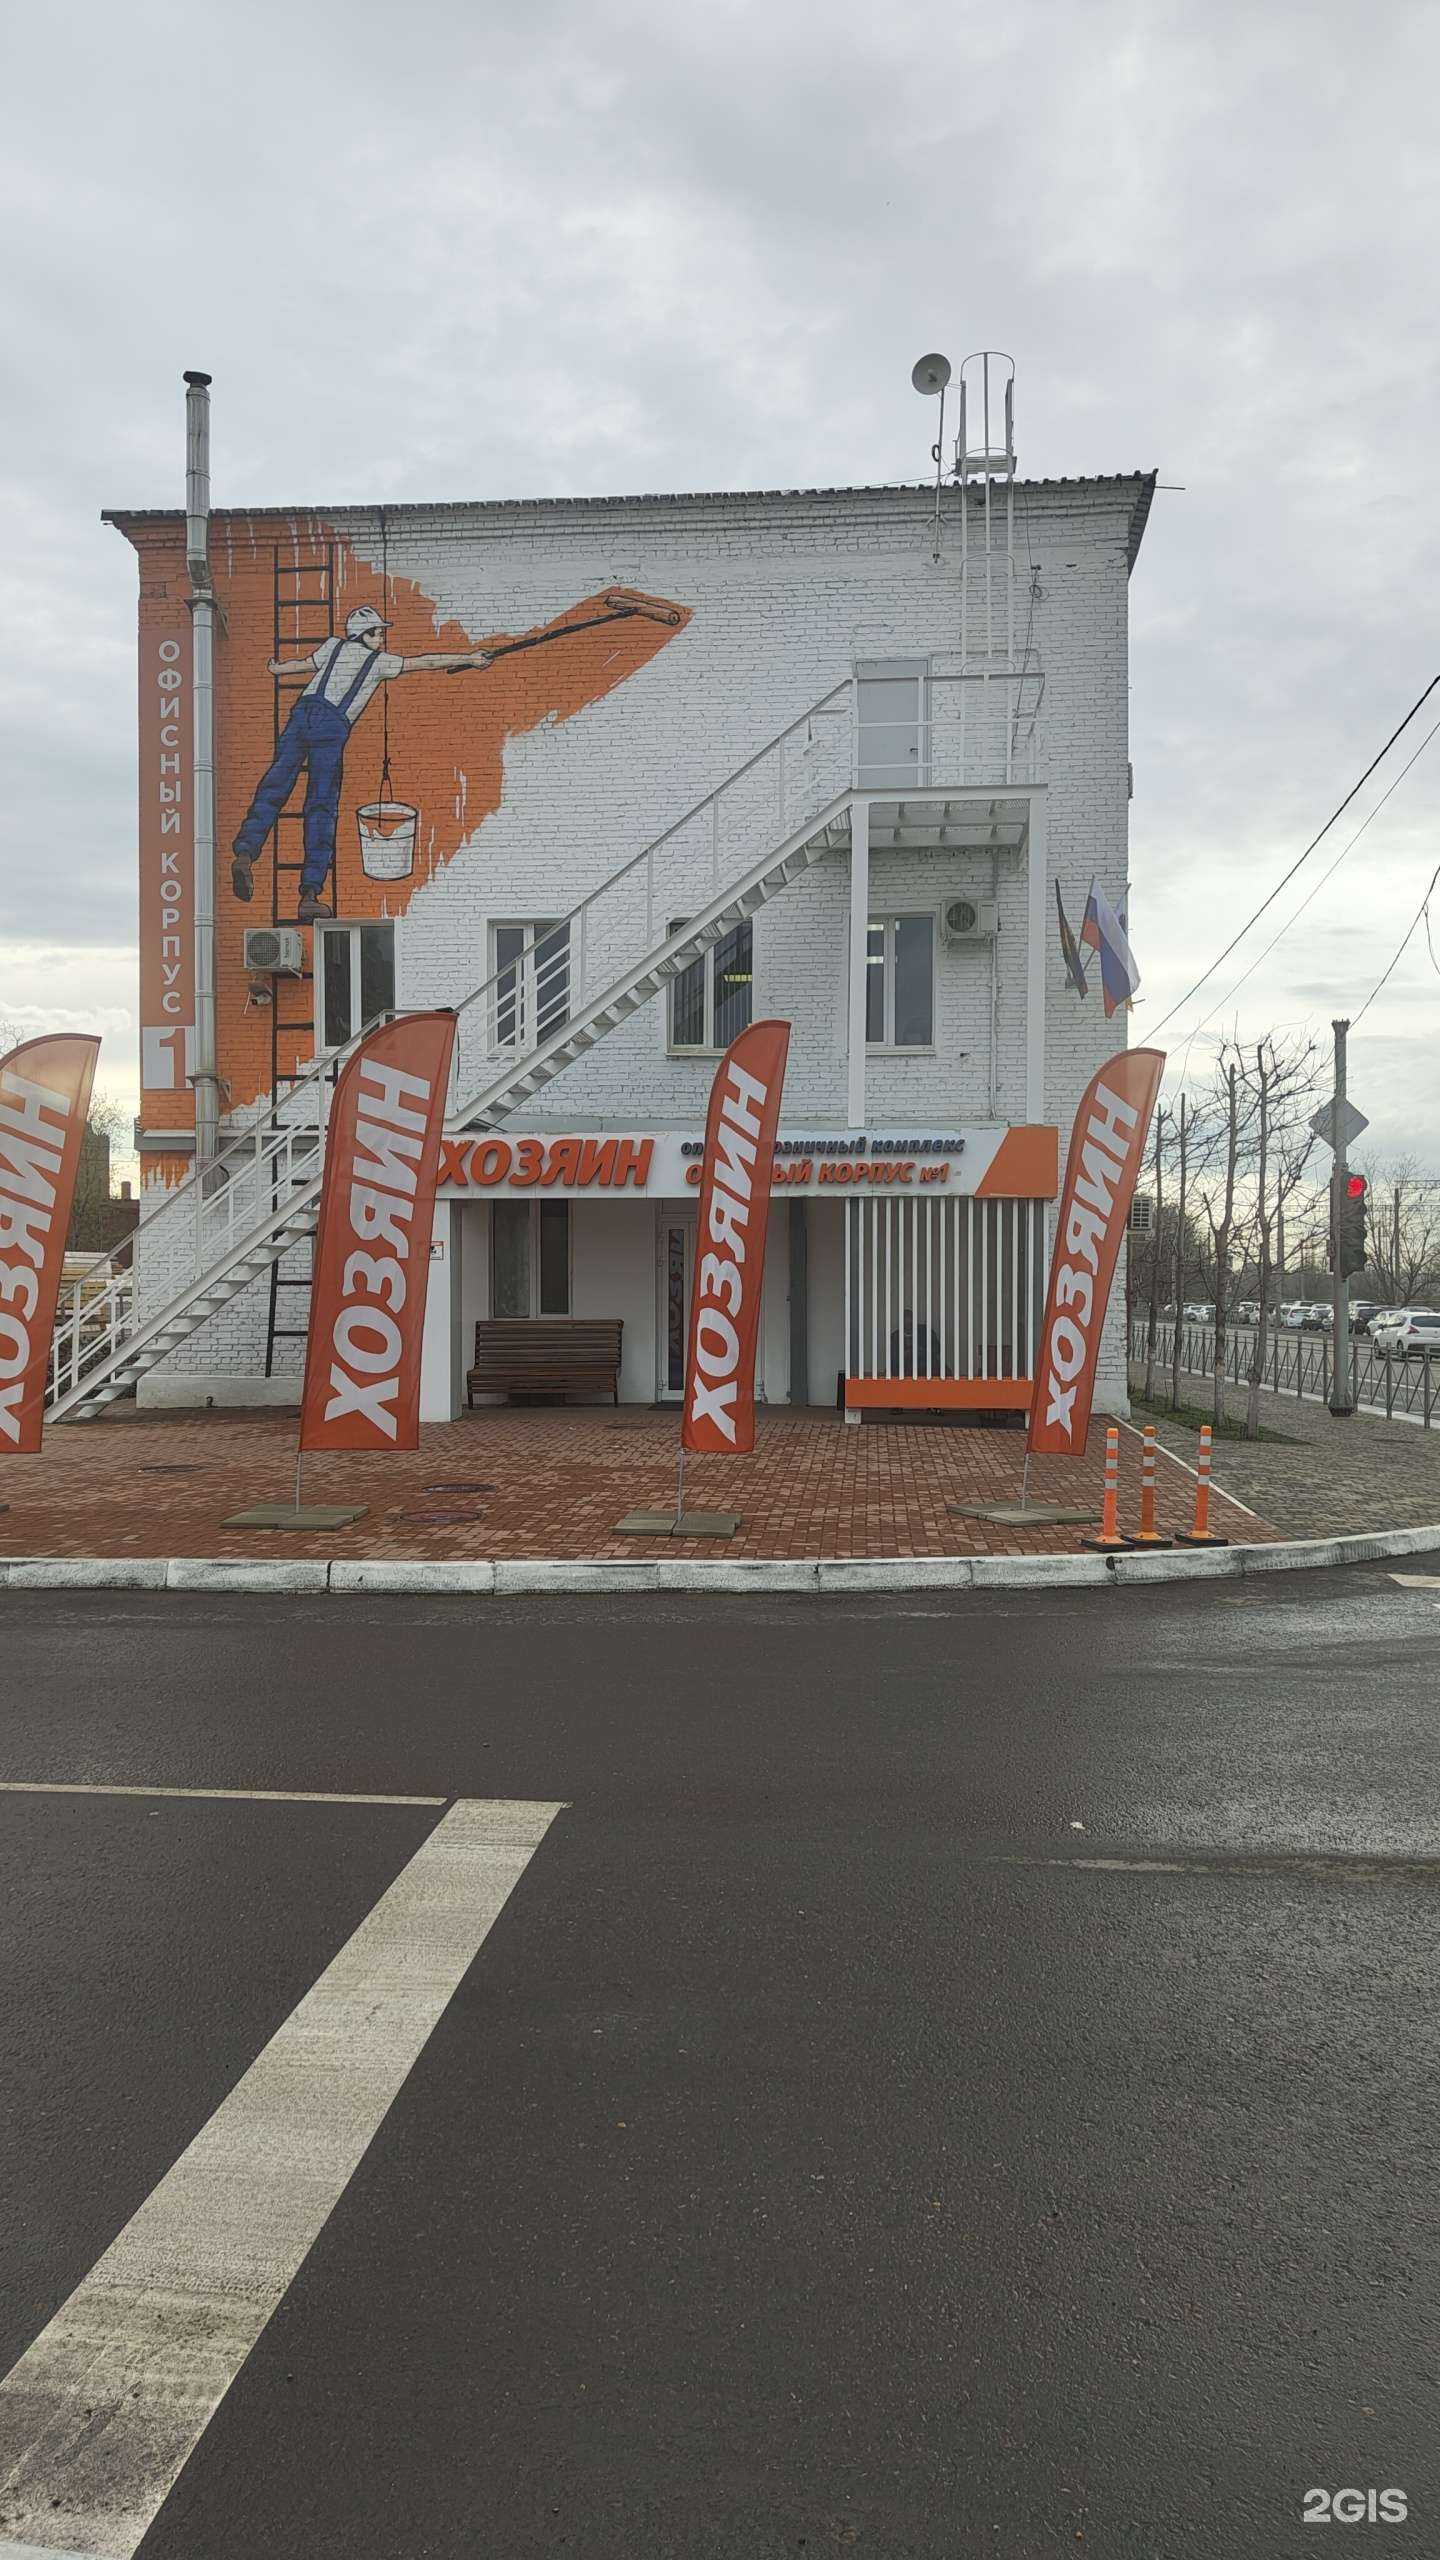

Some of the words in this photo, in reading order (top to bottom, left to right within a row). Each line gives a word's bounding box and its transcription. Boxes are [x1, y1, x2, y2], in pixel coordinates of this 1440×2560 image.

[157, 639, 183, 834] ОФИСНЫЙ
[159, 852, 183, 1013] КОРПУС
[158, 1027, 186, 1088] 1
[437, 1138, 655, 1187] ХОЗЯИН
[817, 1161, 916, 1185] КОРПУС
[919, 1162, 950, 1185] №1
[871, 1137, 966, 1154] комплекс
[324, 1057, 431, 1441] ХОЗЯИН
[691, 1060, 768, 1445] ХОЗЯИН
[1046, 1081, 1139, 1446] ХОЗЯИН
